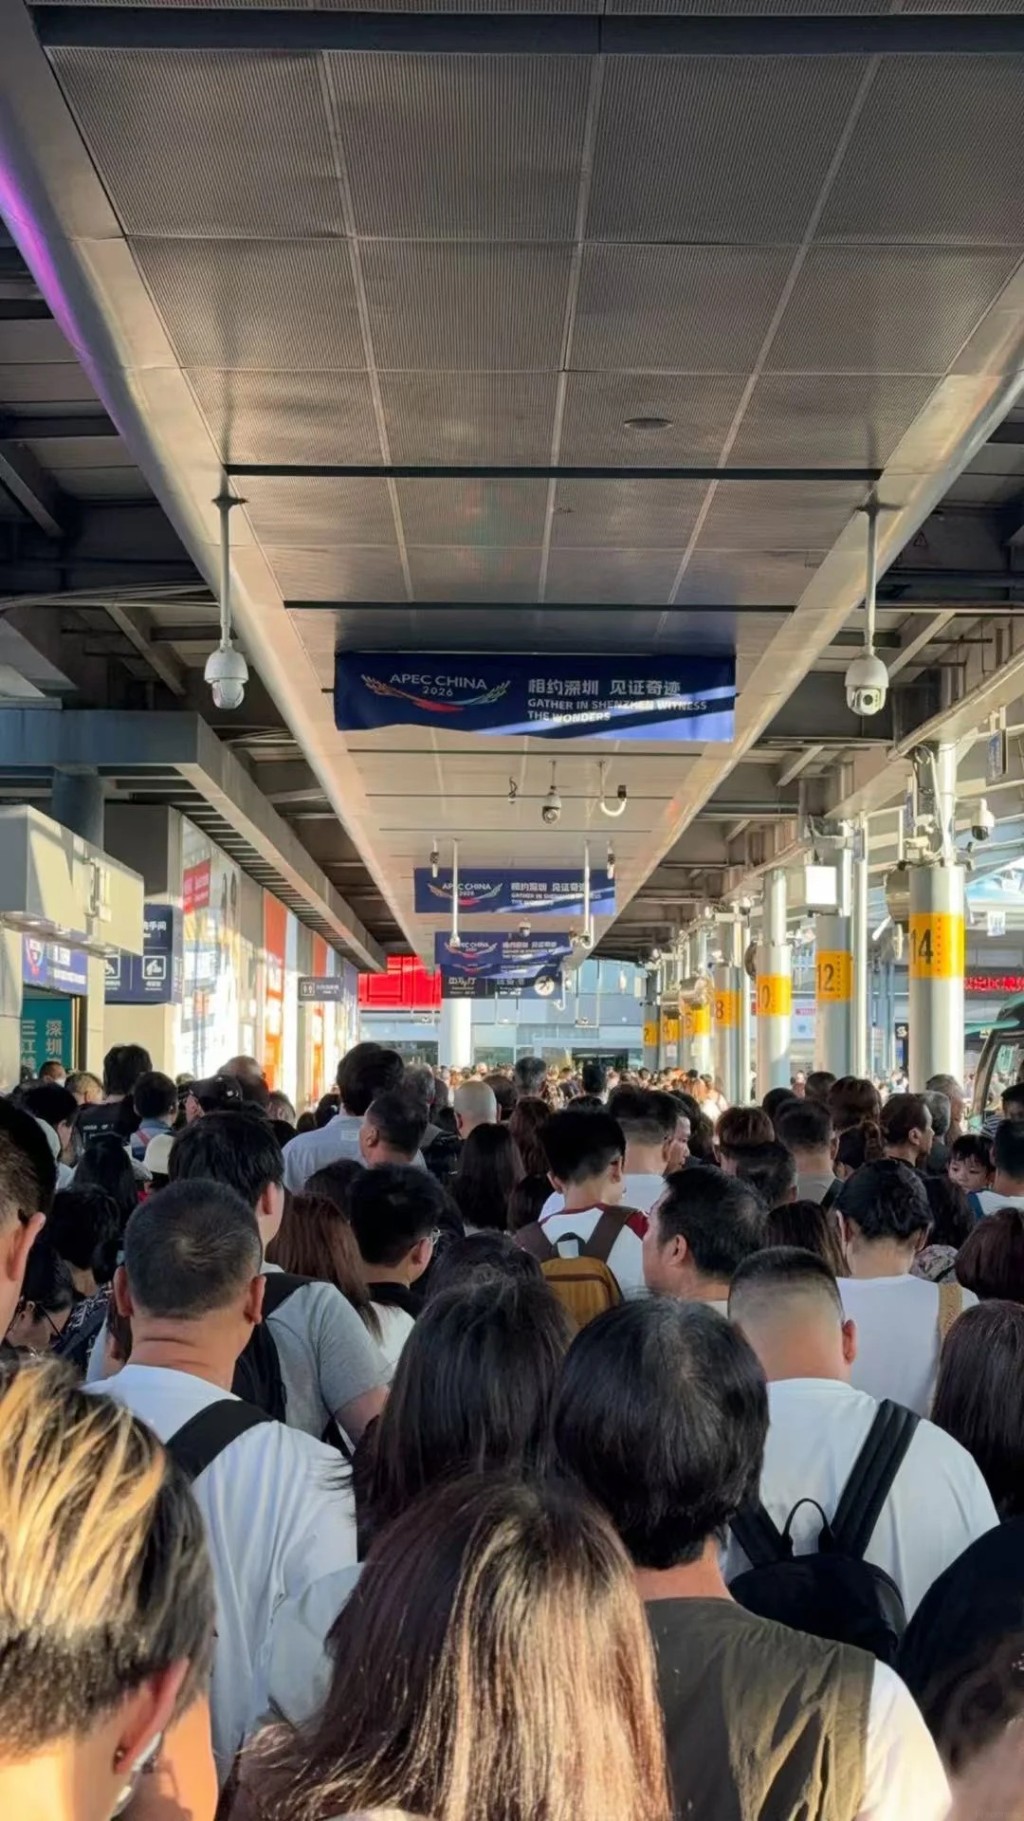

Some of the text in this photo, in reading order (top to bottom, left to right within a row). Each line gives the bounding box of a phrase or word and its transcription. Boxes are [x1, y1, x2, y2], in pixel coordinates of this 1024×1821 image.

[389, 673, 488, 690] APEC CHINA
[527, 678, 681, 696] 相约深圳 见证奇迹
[422, 685, 454, 697] 2026
[527, 698, 707, 711] GATHER IN SHENZHEN WITNESS
[527, 710, 611, 723] THE WONDERS
[442, 882, 492, 890] APC CHINA
[910, 927, 934, 965] 14
[816, 962, 835, 992] 12
[714, 998, 724, 1020] 8
[45, 1019, 63, 1062] 深圳
